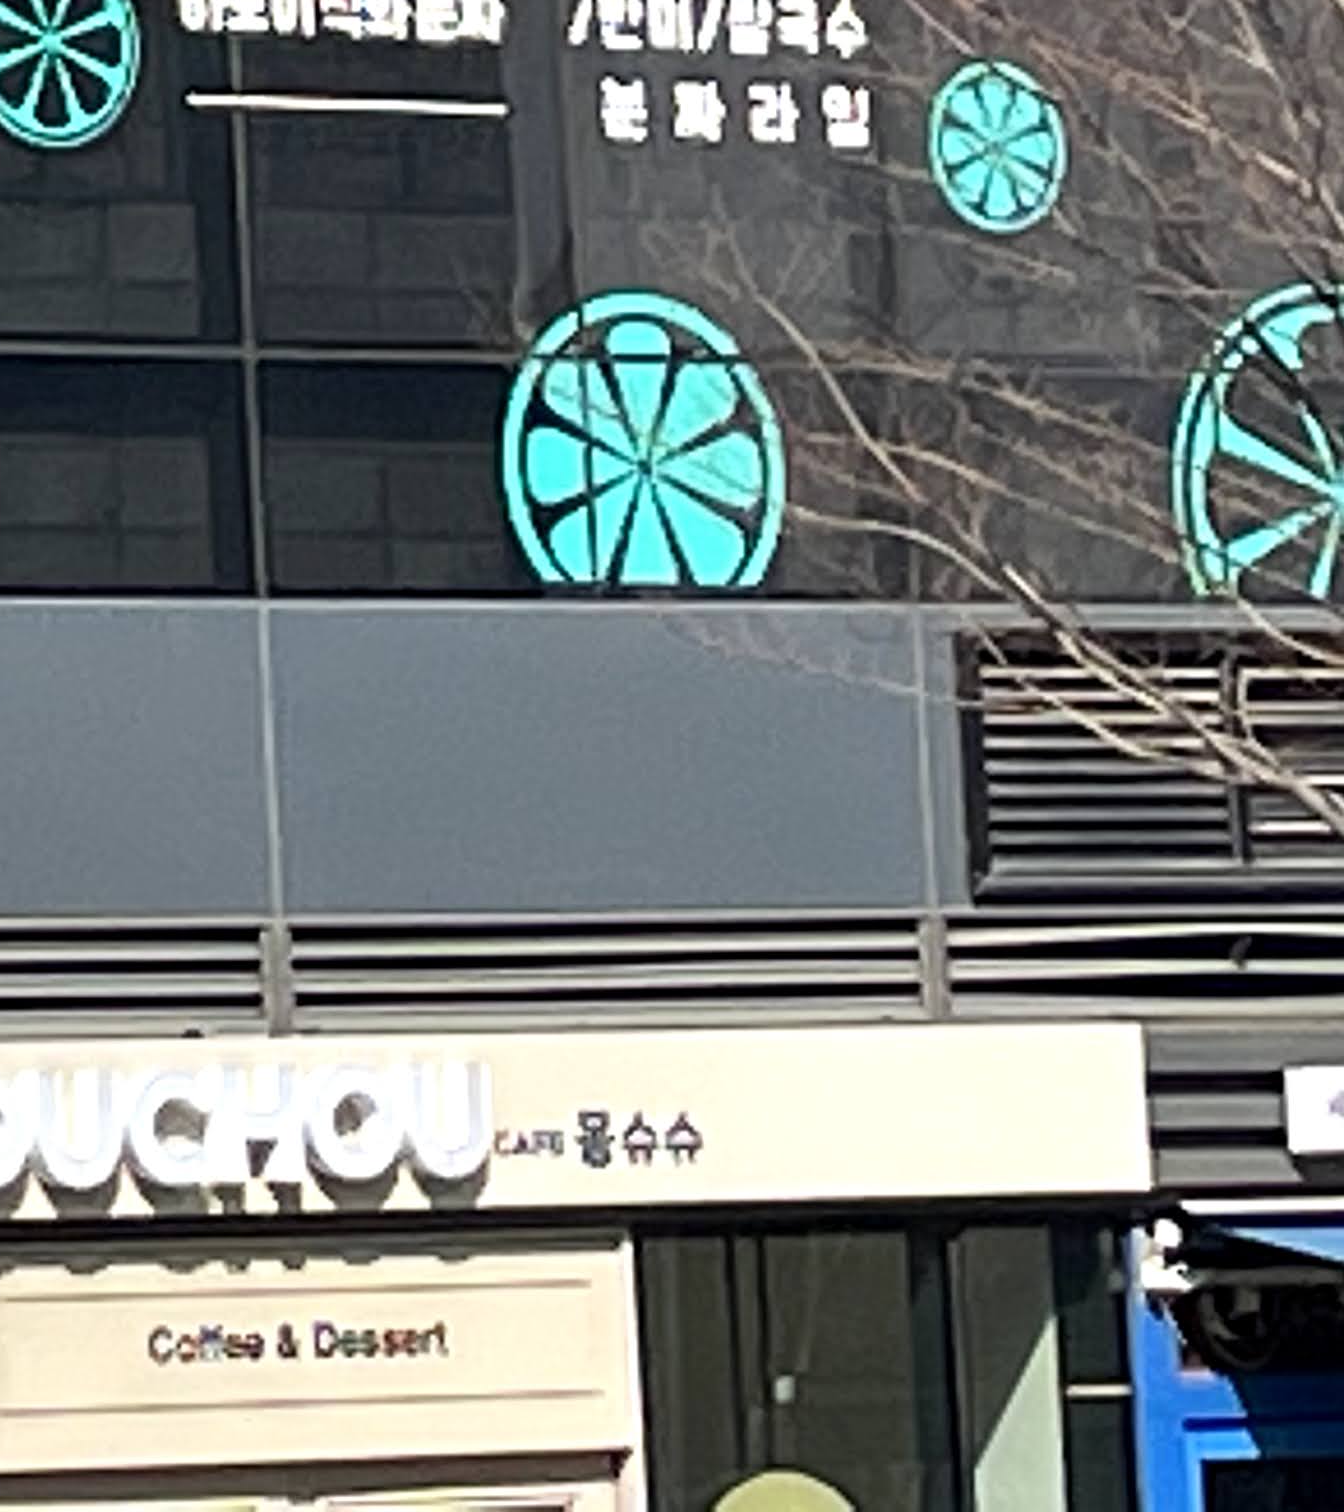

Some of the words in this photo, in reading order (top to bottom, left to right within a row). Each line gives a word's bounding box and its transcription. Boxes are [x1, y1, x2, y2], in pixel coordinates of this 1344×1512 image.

[147, 1323, 266, 1366] Coffee
[277, 1320, 300, 1360] &
[311, 1319, 450, 1361] Dessert
